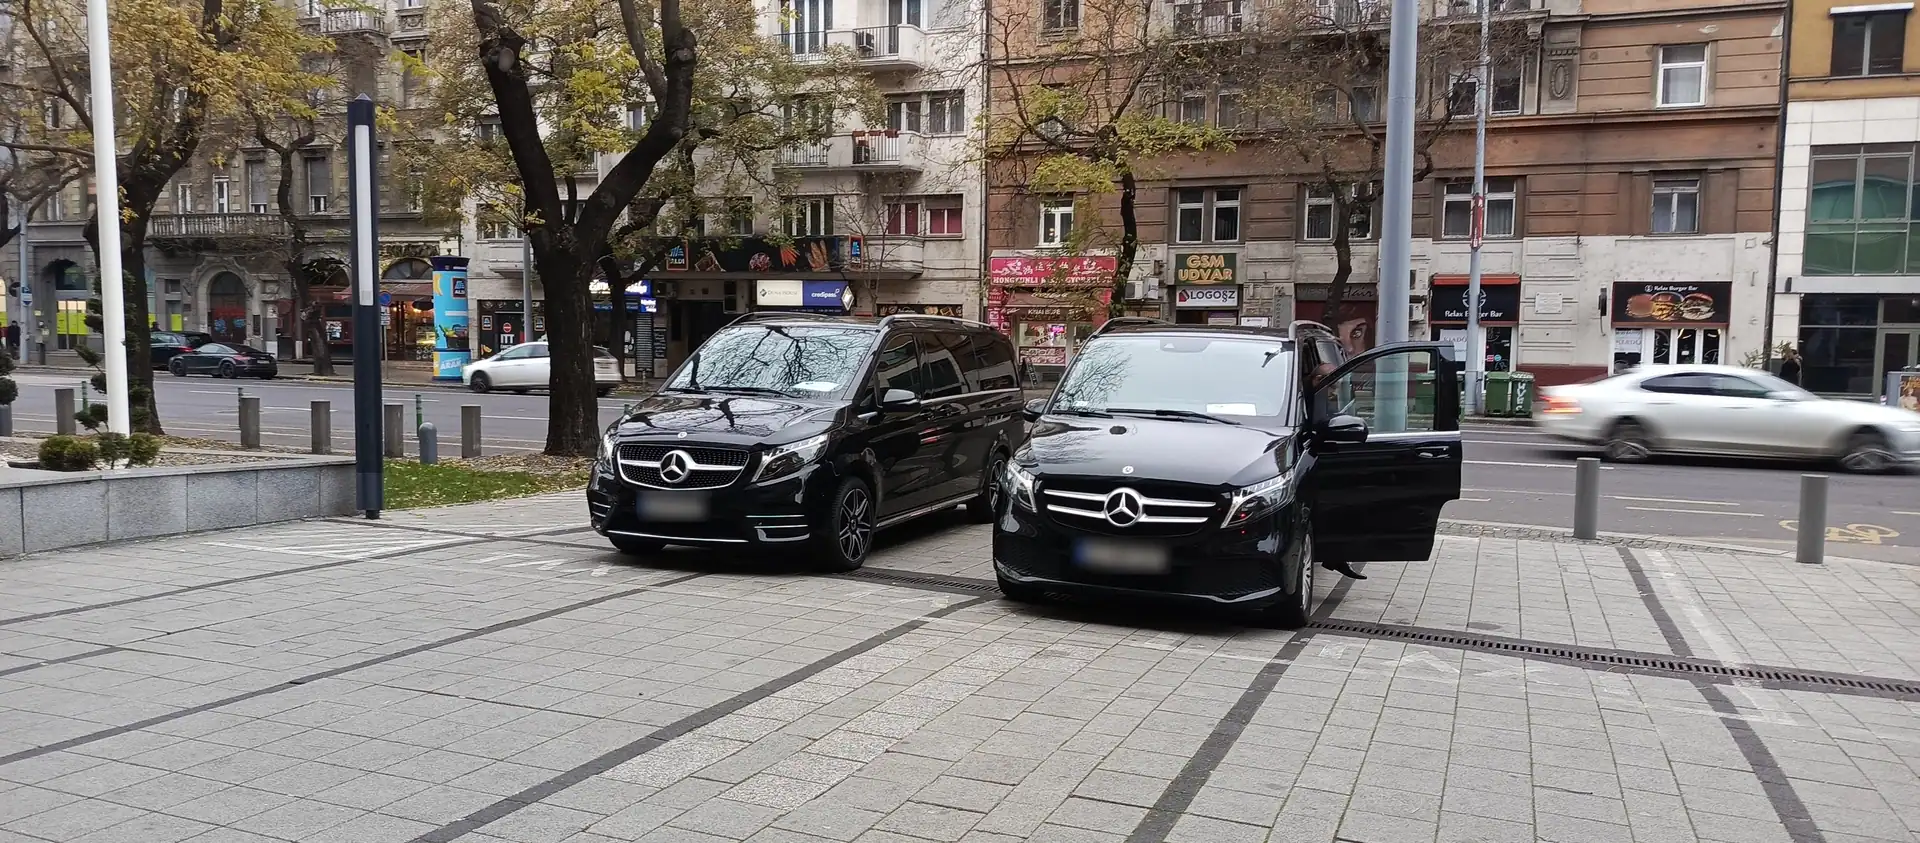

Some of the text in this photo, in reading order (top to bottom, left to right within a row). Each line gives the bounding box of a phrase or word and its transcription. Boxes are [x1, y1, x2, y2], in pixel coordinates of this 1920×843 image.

[1186, 255, 1224, 268] GSM
[1178, 268, 1232, 280] UDVAR
[500, 334, 514, 344] ITT
